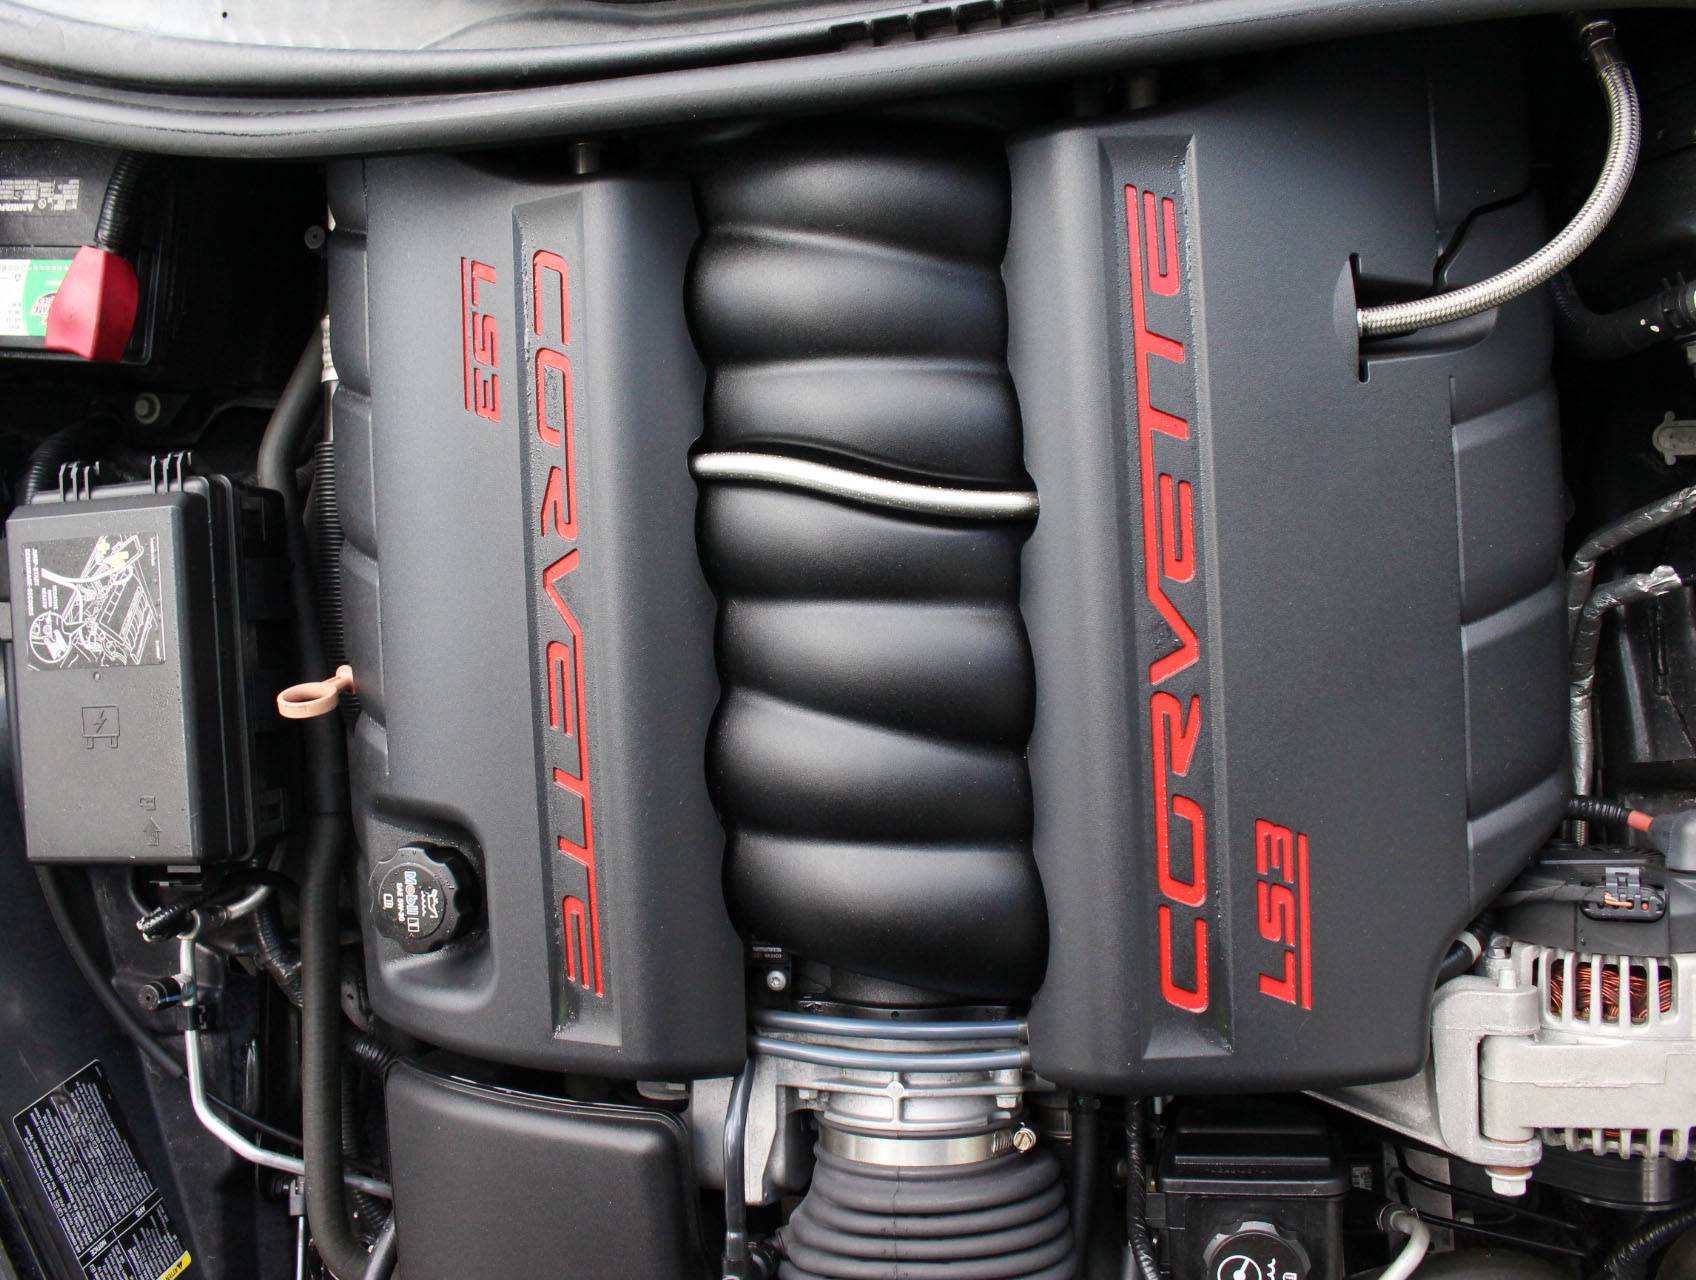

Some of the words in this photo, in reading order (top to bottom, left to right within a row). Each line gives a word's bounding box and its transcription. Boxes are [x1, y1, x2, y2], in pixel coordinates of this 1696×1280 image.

[461, 256, 502, 423] LS3
[531, 249, 606, 999] CORVETTE
[1125, 184, 1210, 1013] CORVETTE
[396, 882, 404, 897] SAE
[404, 870, 419, 915] Mobil
[1254, 818, 1314, 1012] LS3
[89, 1238, 108, 1257] NOTICE
